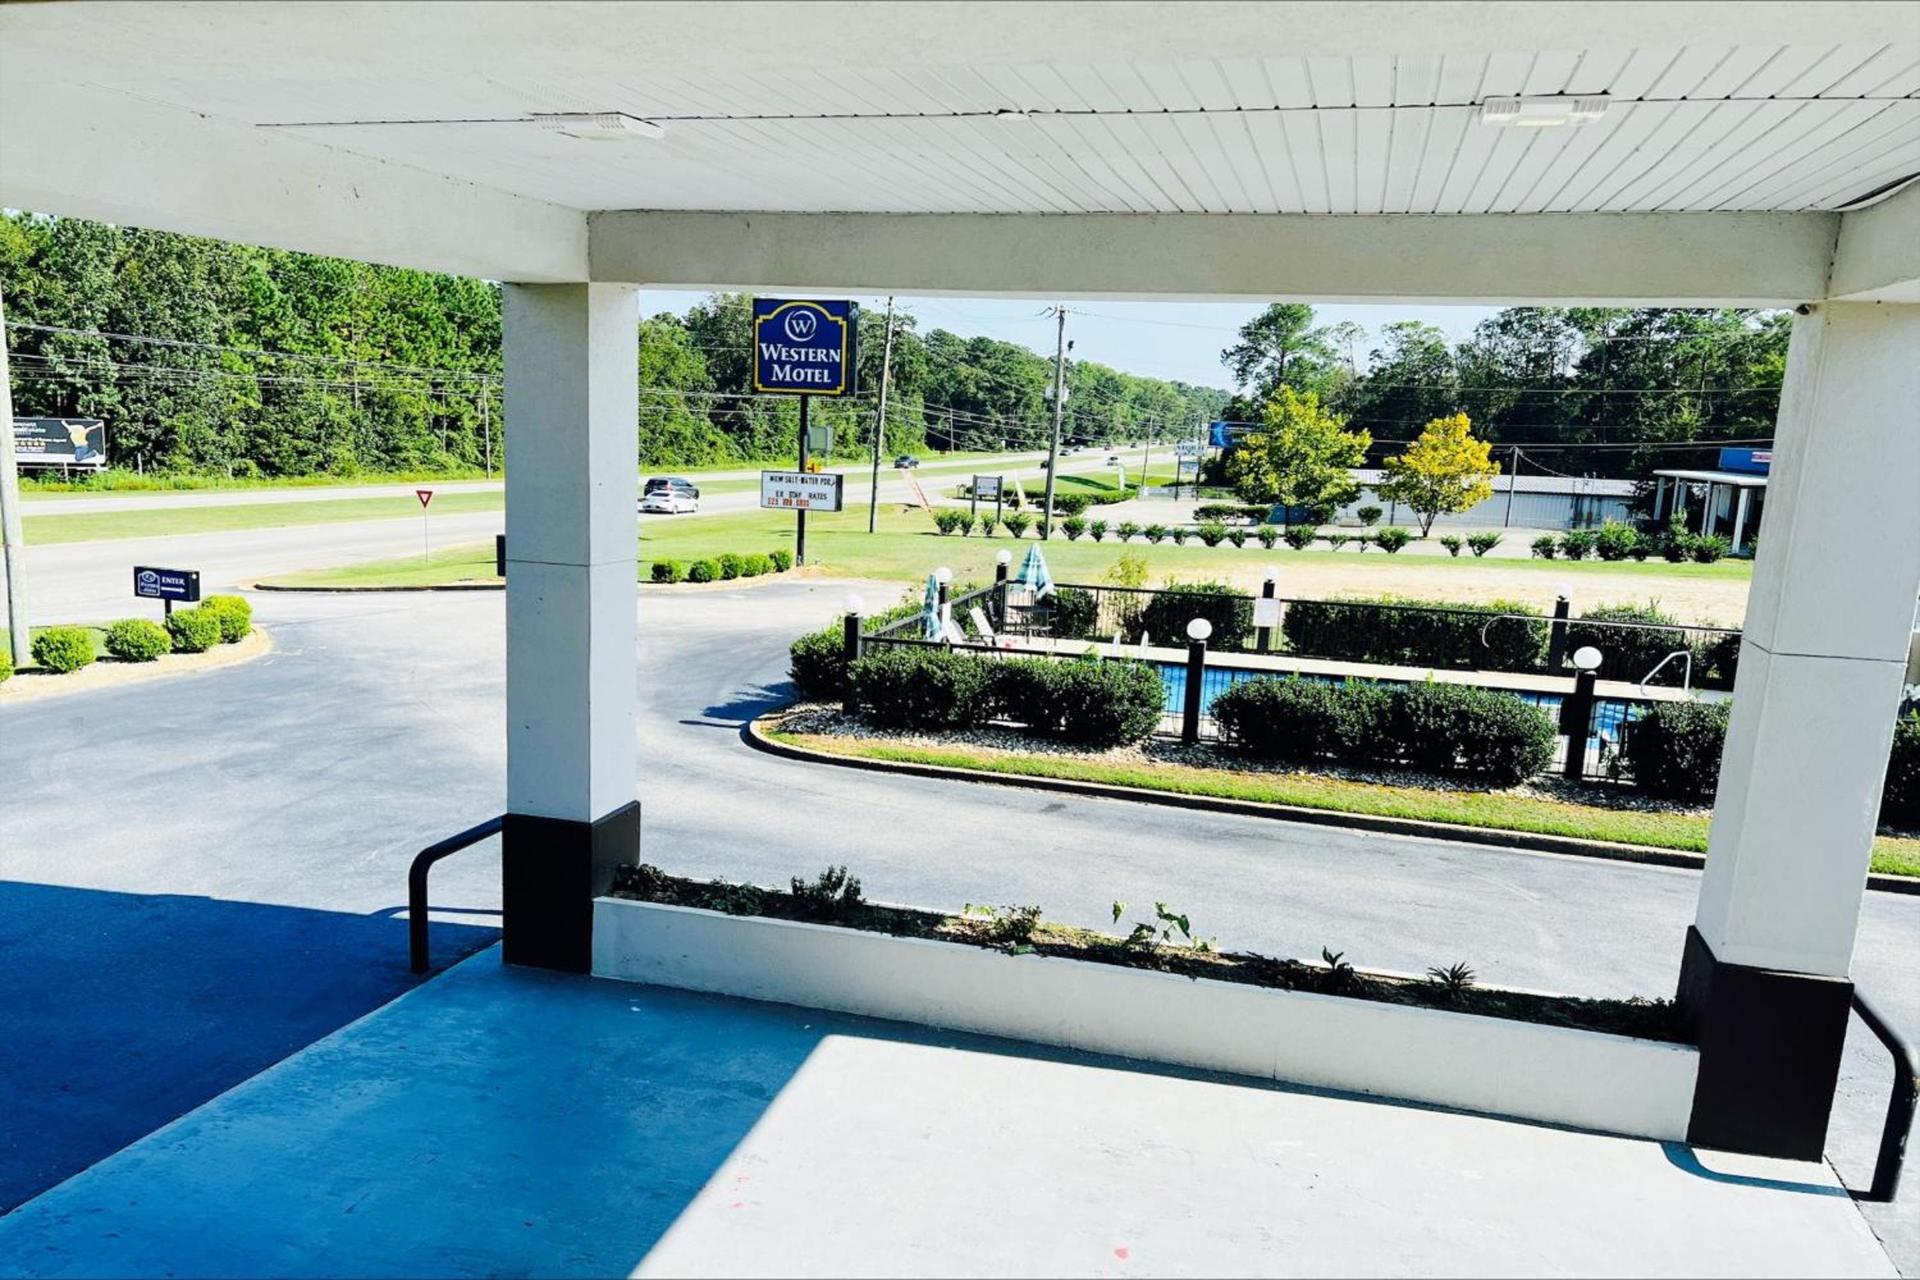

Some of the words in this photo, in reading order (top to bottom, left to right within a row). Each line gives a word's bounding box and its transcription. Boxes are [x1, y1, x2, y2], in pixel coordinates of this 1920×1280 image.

[760, 342, 841, 363] WESTERN
[771, 363, 832, 383] MOTEL
[161, 576, 186, 586] ENTER
